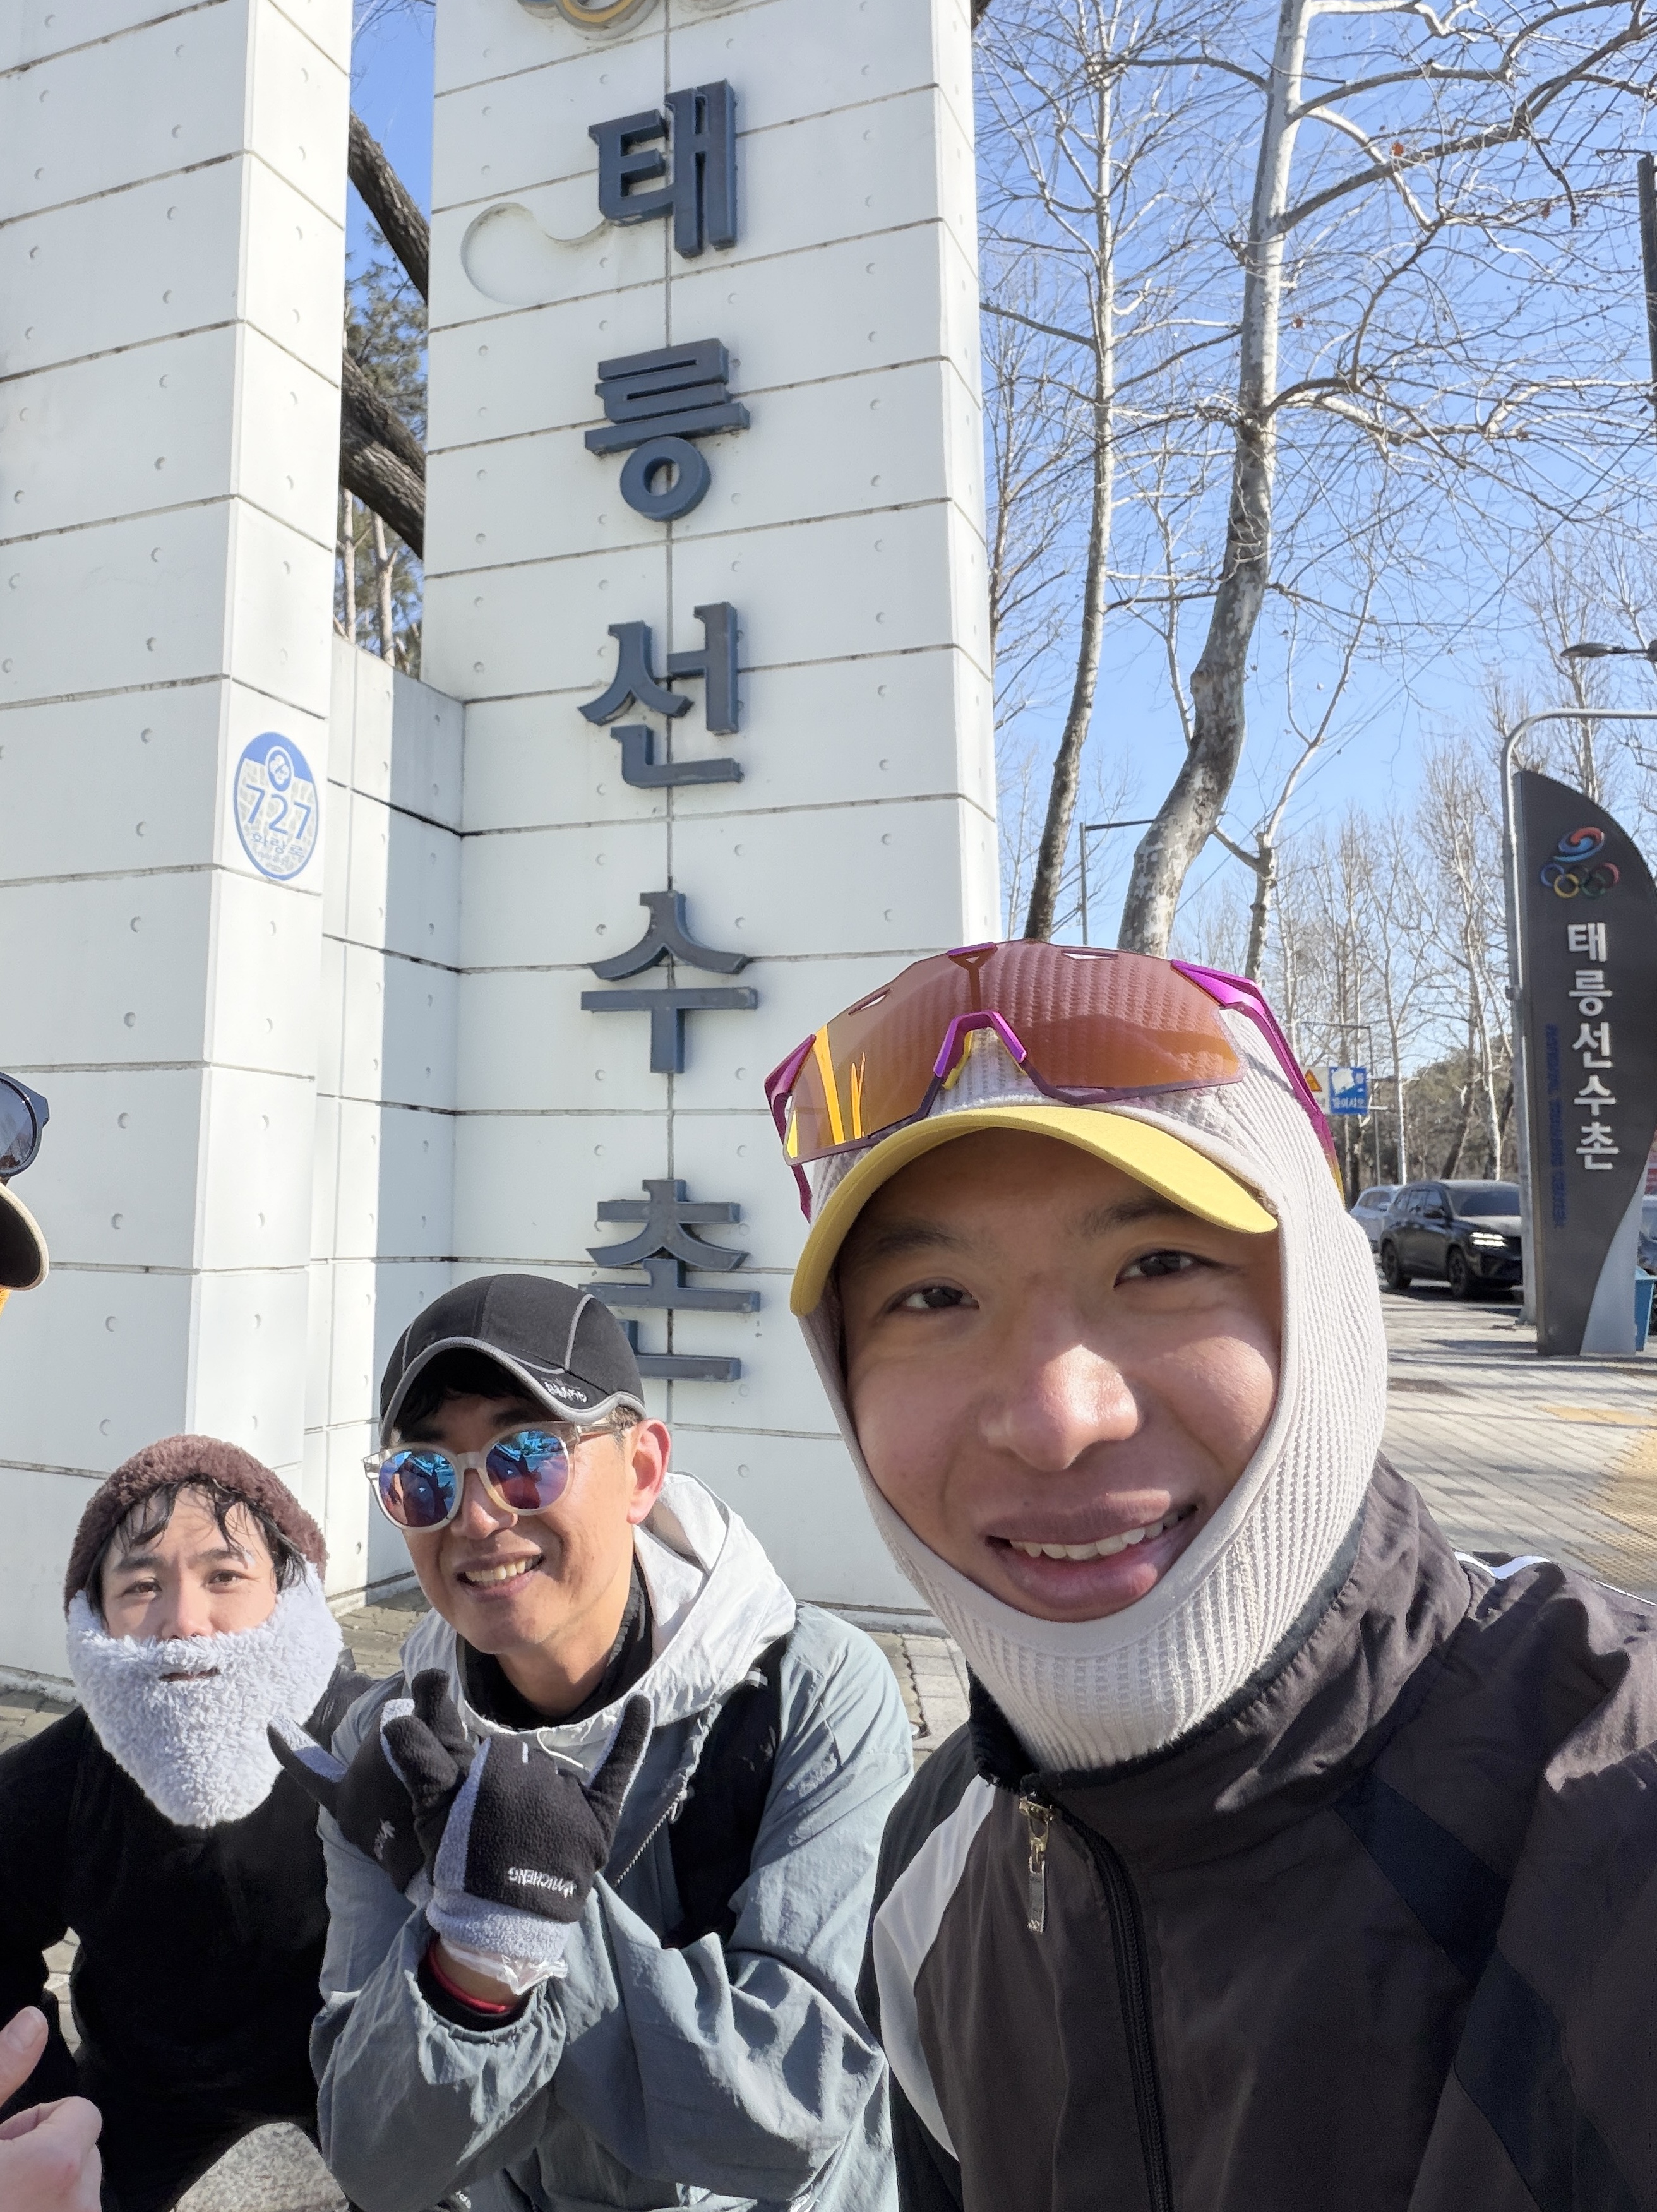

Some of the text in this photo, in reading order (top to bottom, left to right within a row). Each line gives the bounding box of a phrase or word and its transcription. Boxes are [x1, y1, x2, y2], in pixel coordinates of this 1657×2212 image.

[577, 78, 760, 1383] 태릉선수촌
[246, 783, 311, 840] 727
[251, 831, 305, 858] 화랑로
[1567, 921, 1620, 1171] 태릉선수촌
